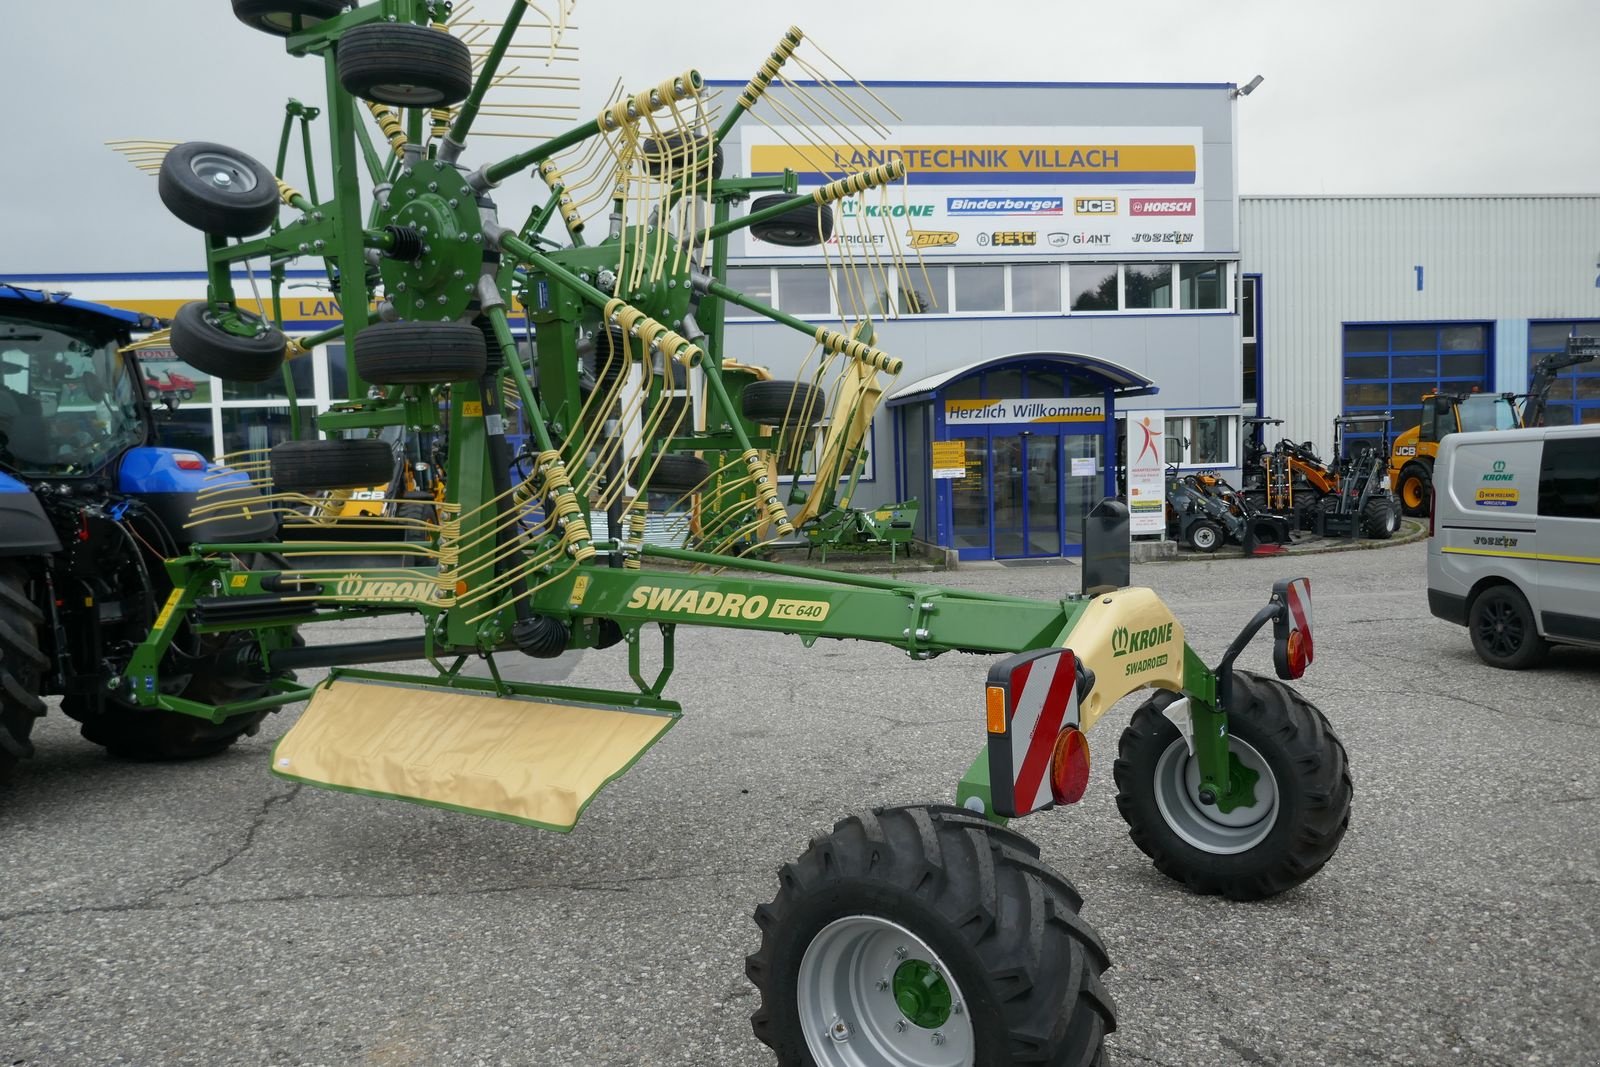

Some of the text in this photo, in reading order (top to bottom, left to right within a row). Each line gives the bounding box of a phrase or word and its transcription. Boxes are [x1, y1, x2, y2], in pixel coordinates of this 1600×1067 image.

[834, 149, 1119, 168] LANDTECHNIK VILLACH
[864, 205, 935, 217] KRONE
[951, 198, 1060, 211] Binderberger
[1077, 200, 1116, 212] JCB
[1143, 202, 1192, 212] HORSCH
[1414, 266, 1424, 291] 1
[949, 403, 1101, 419] Herzlich Willkommen
[1395, 446, 1416, 456] JCB
[1482, 473, 1514, 481] KRONE
[627, 585, 822, 620] SWADRO TC 640
[1128, 622, 1173, 654] KRONE
[1125, 656, 1156, 677] SWADRO
